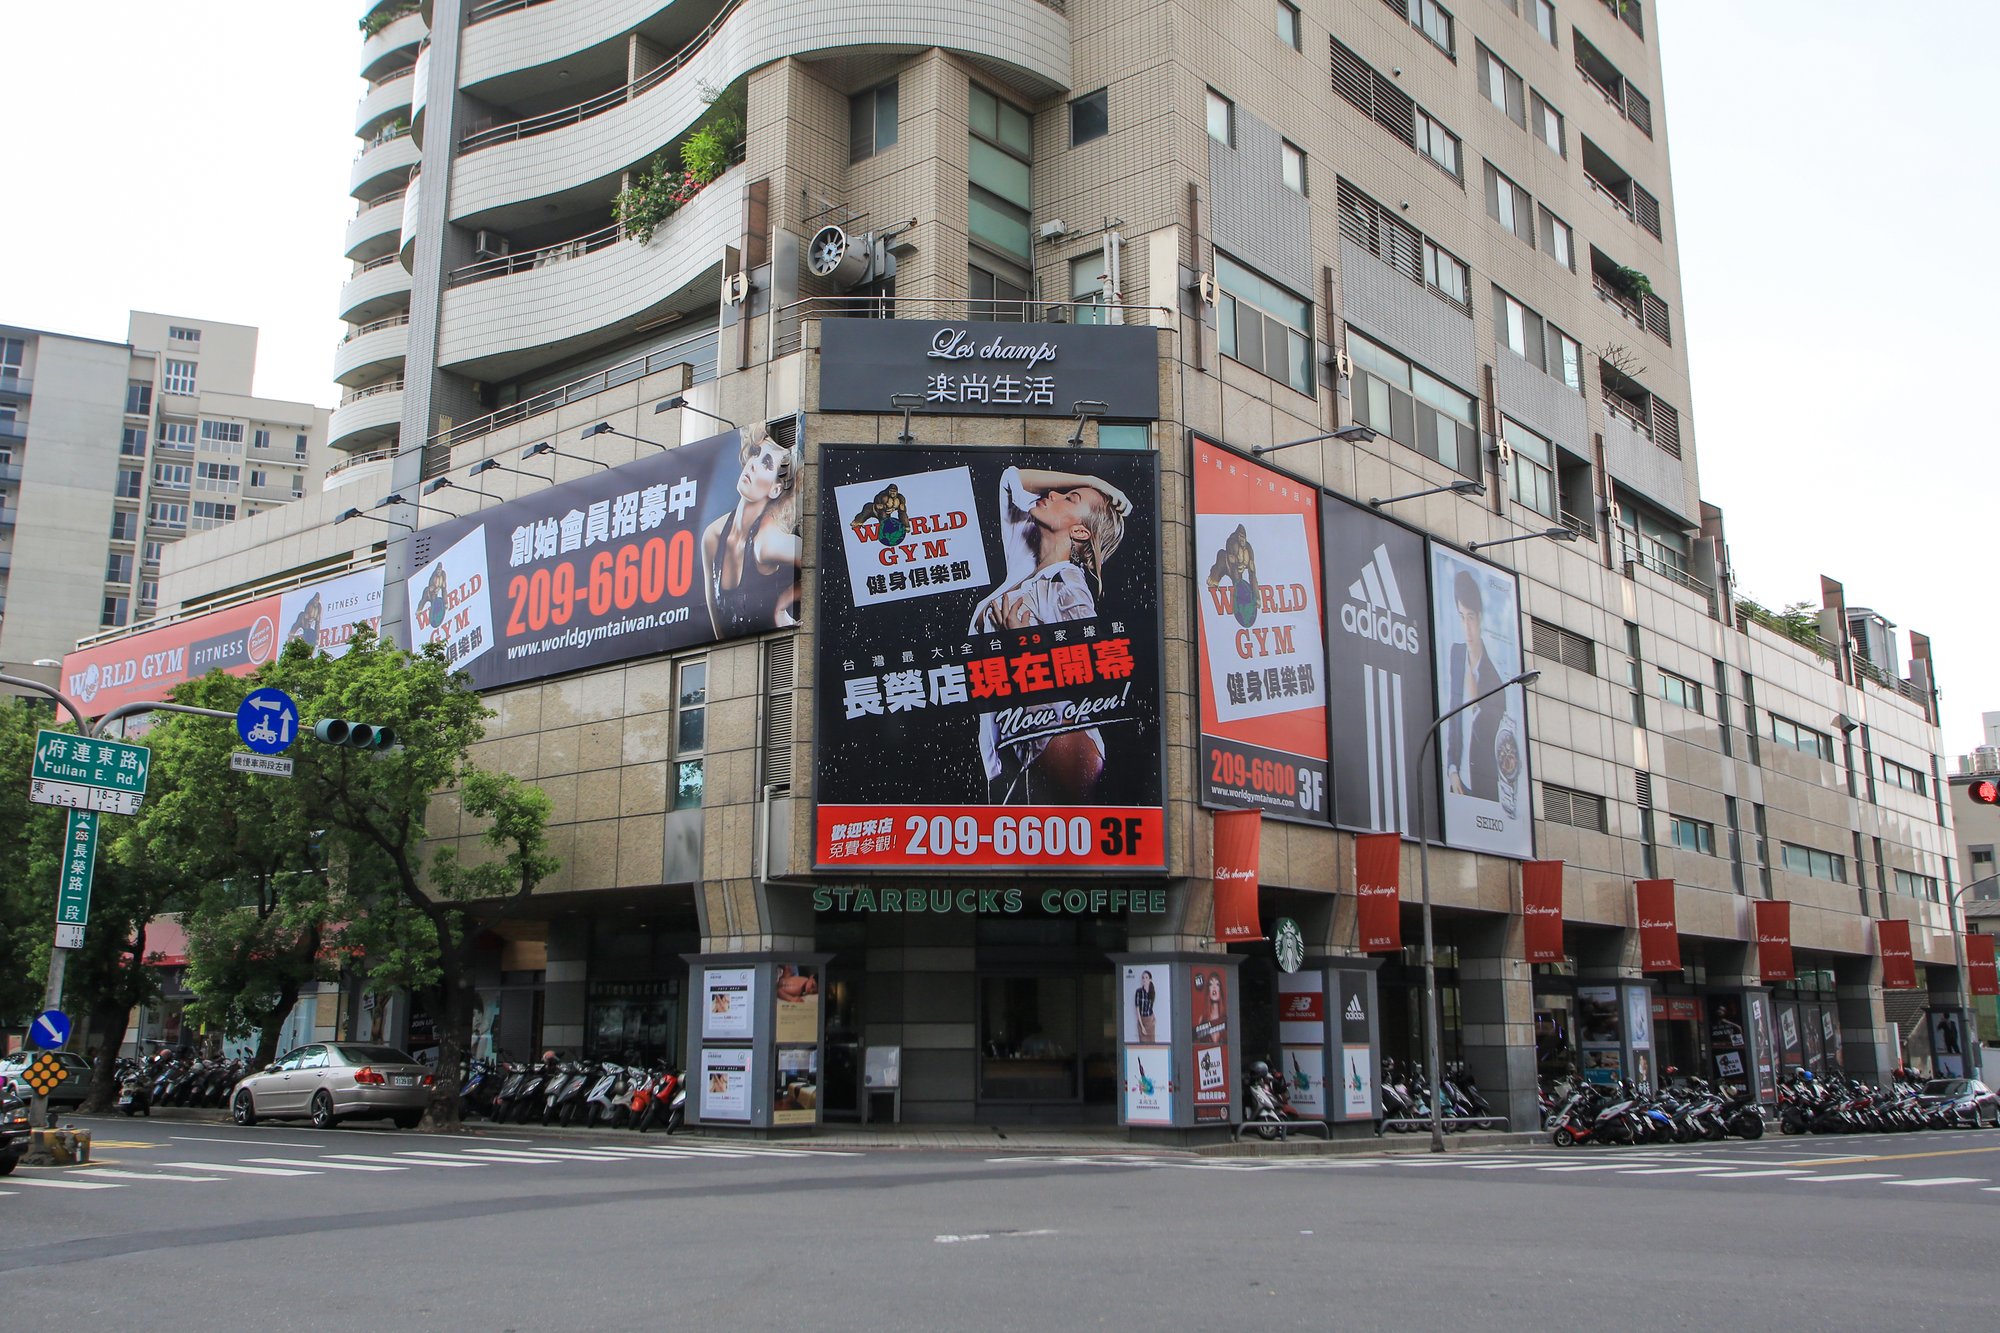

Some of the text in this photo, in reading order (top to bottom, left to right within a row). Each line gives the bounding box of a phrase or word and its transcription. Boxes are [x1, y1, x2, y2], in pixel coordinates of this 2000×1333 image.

[926, 327, 1058, 369] Les champs
[926, 372, 1056, 405] 楽尚生活
[509, 476, 698, 568] 創始會員招募中
[879, 539, 949, 566] GYM
[506, 530, 694, 637] 209-6600
[866, 561, 972, 595] 健身俱樂部
[327, 596, 359, 611] FITNESS
[430, 607, 470, 644] GYM
[507, 606, 690, 659] www.worldgymtaiwan.com
[1235, 625, 1296, 659] GYM
[1340, 600, 1420, 655] adidas
[141, 646, 185, 680] GYM
[194, 639, 244, 665] FITNESS
[446, 625, 482, 661] 俱樂部
[842, 638, 1136, 720] 長榮店現在開幕
[1226, 663, 1315, 706] 健身俱樂部
[996, 682, 1132, 735] Now open!
[46, 738, 139, 770] 府連東路
[32, 781, 46, 794] 東
[43, 761, 136, 786] Fulian E. Rd.
[1211, 749, 1295, 797] 209-6600
[1298, 767, 1324, 812] 3F
[50, 794, 77, 807] 13-5
[96, 790, 121, 802] 18-2
[98, 801, 119, 813] 1-1
[131, 795, 143, 807] 西
[1211, 785, 1295, 808] www.worldgymtaiwan.com
[75, 831, 89, 841] 255
[905, 815, 1143, 856] 209-6600 3F
[1475, 815, 1504, 832] SEIKO
[829, 835, 897, 859] 免費參觀!
[65, 843, 88, 921] 長榮路一段
[812, 888, 1166, 913] STARBUCKS COFFEE
[72, 926, 85, 935] 111
[1345, 1012, 1365, 1020] adidas
